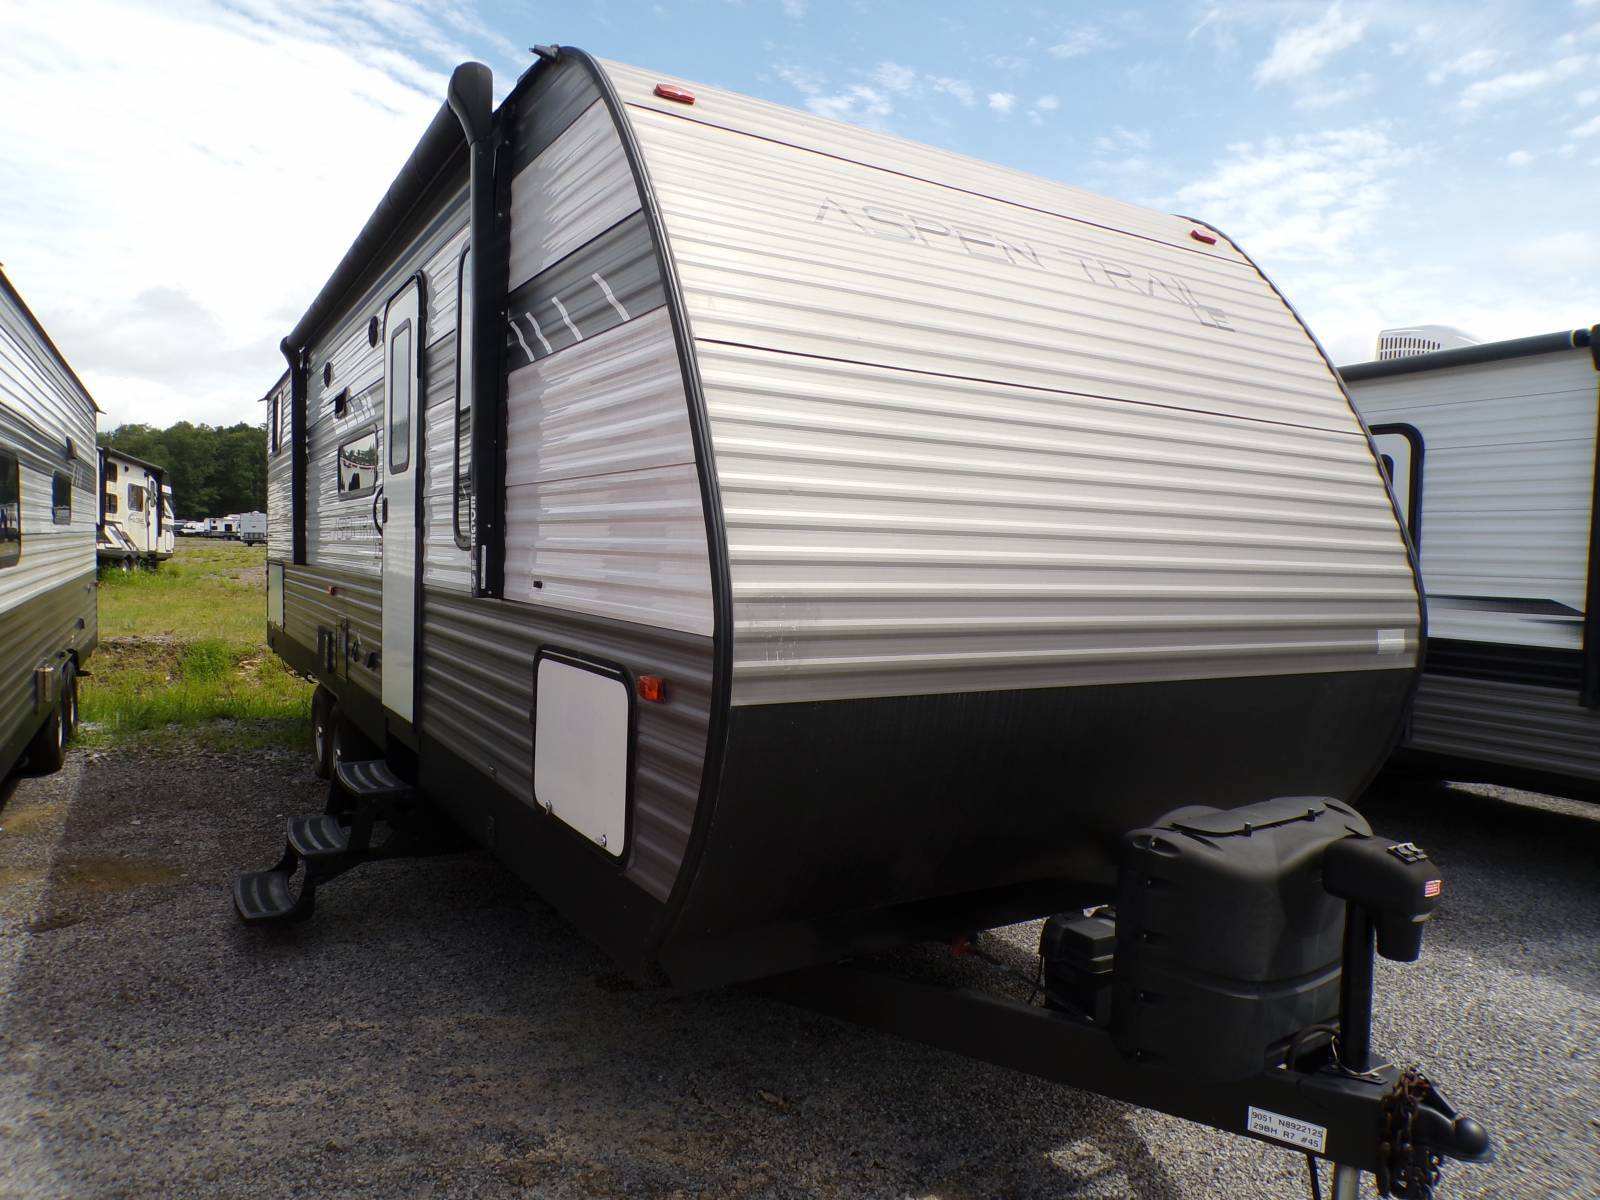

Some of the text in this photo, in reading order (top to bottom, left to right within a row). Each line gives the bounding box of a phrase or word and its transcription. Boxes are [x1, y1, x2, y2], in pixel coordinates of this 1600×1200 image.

[815, 197, 1047, 270] ASPEN
[1252, 1111, 1324, 1138] 9051 N8922125
[1253, 1122, 1319, 1148] 29BH R7 #45
